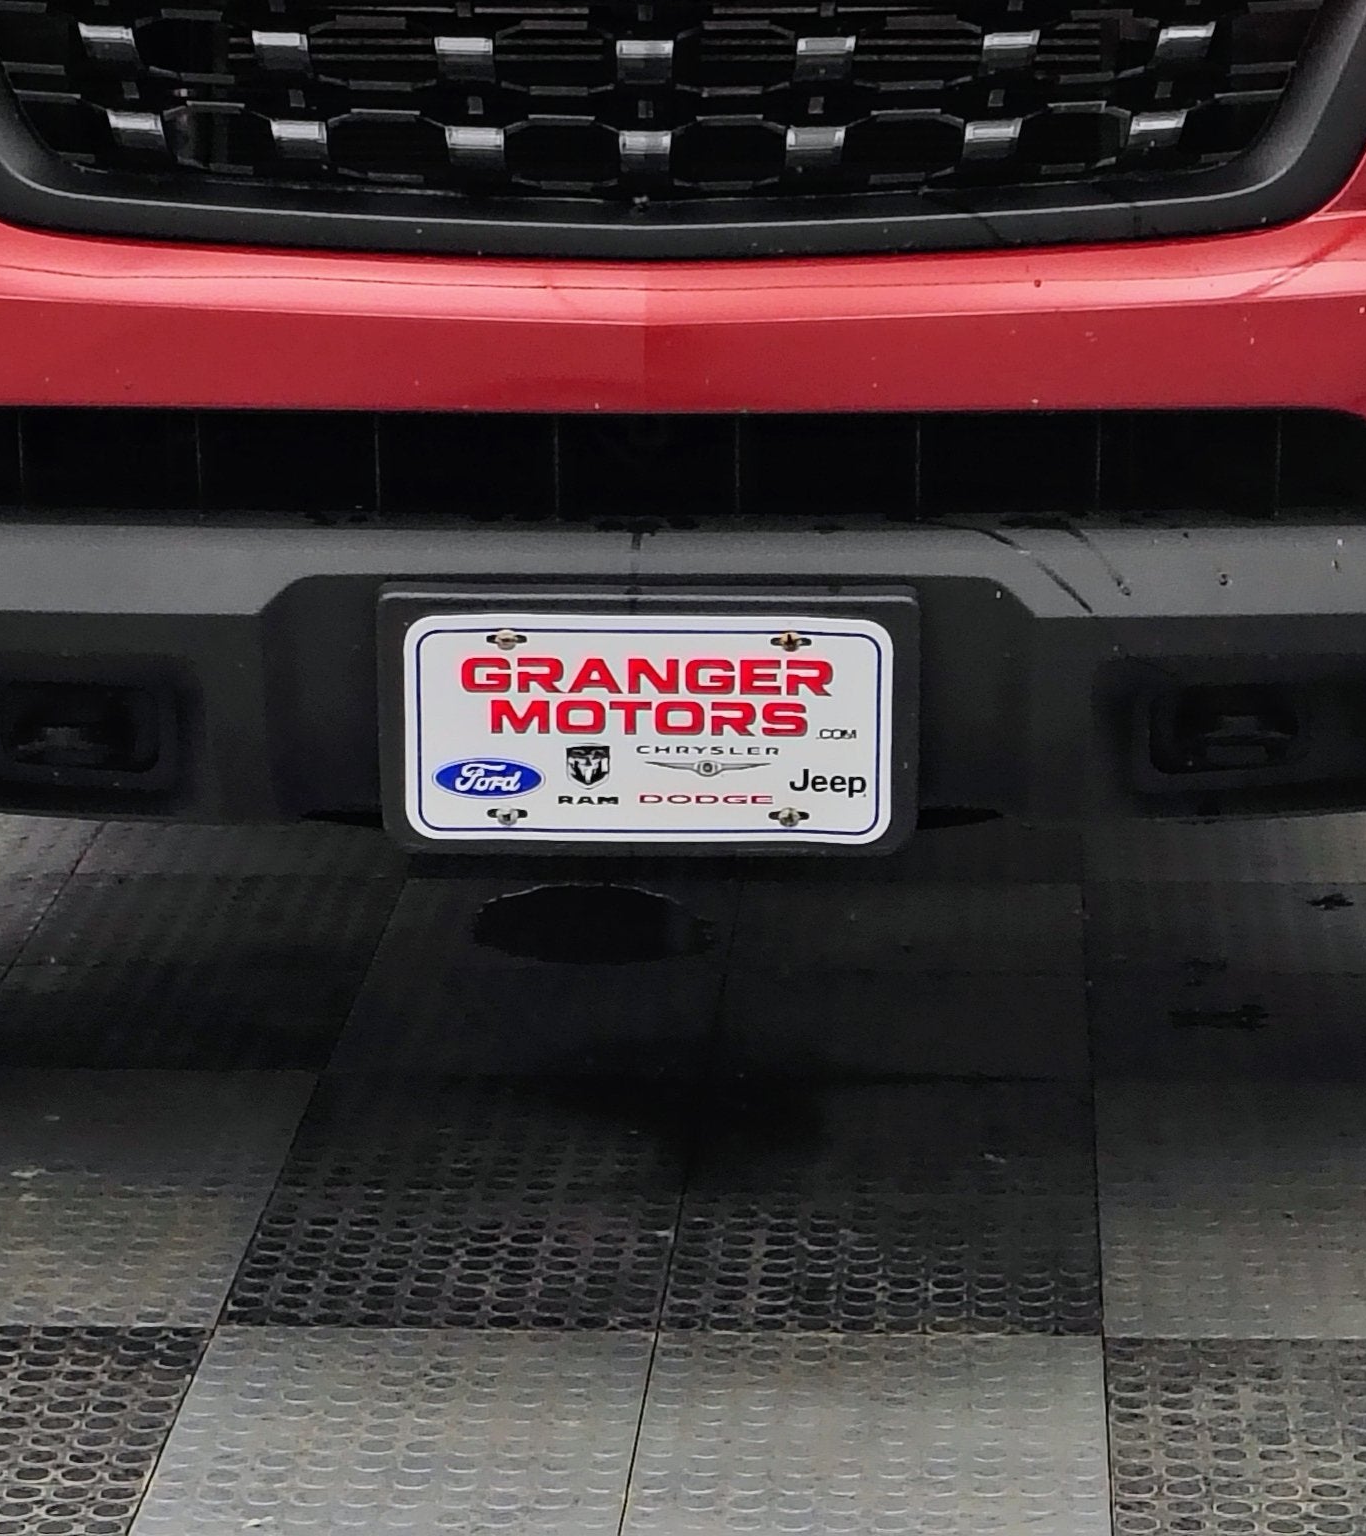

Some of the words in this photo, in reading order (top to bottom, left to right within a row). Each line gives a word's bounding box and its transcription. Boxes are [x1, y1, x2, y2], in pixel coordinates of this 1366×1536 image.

[460, 656, 834, 696] GRANGER
[490, 699, 809, 738] MOTORS
[636, 745, 780, 756] CHRYSLER
[454, 763, 522, 793] Ford
[789, 768, 867, 798] Jeep
[558, 795, 619, 806] RAM
[639, 794, 774, 805] DODGE
